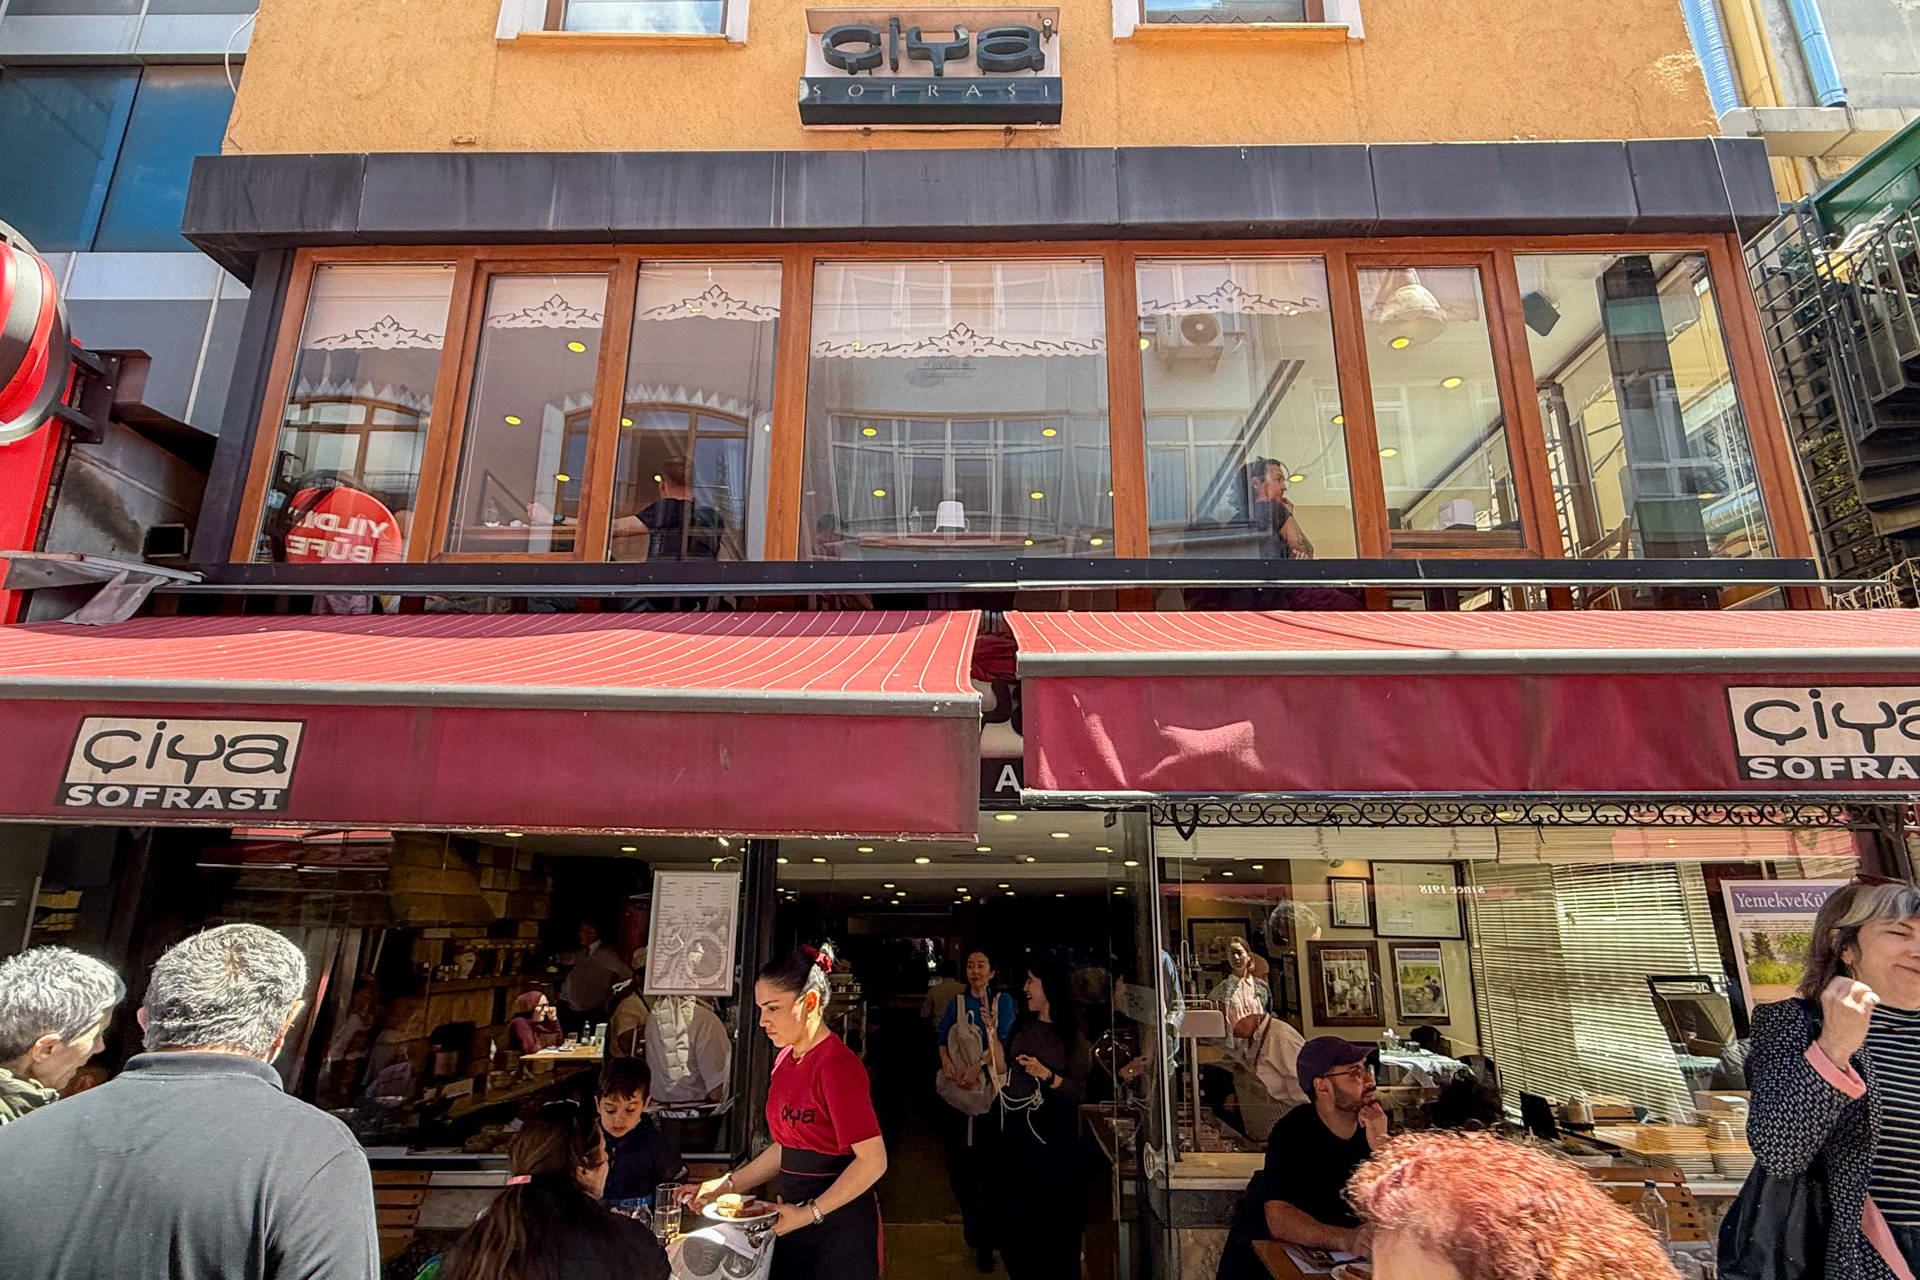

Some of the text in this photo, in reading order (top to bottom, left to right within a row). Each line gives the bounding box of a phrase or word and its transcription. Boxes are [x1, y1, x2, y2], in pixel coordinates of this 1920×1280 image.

[812, 82, 1049, 98] SOFRASI
[1747, 757, 1920, 780] SOFRA
[64, 784, 282, 811] SOFRASI
